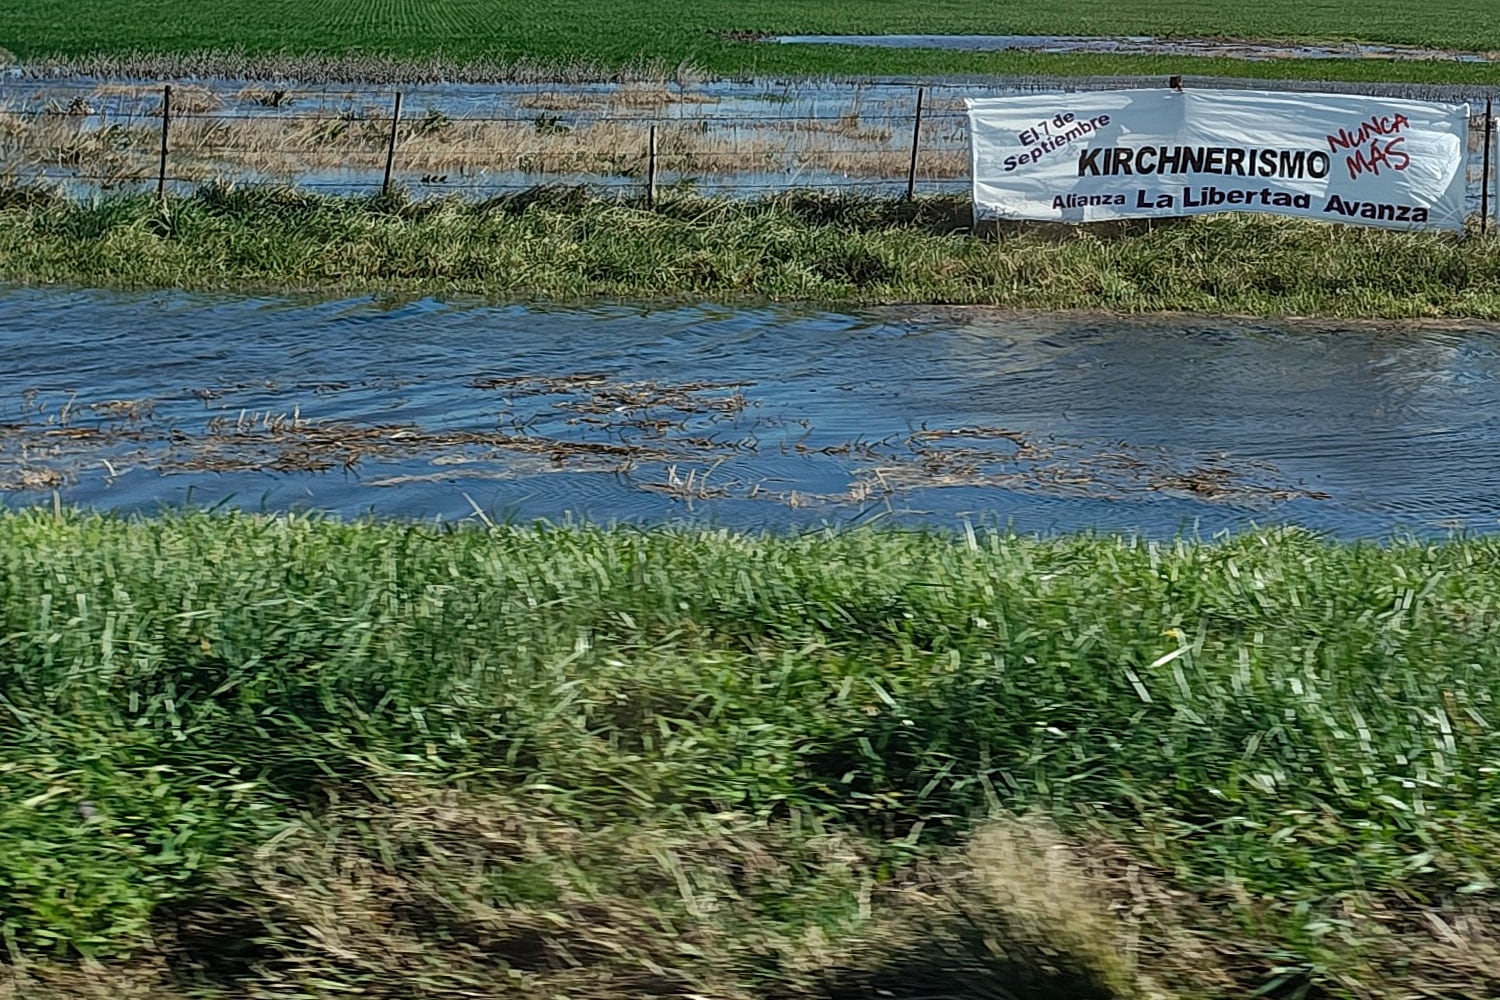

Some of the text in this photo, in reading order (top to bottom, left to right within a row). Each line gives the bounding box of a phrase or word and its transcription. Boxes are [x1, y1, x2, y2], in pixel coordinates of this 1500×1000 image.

[1003, 114, 1110, 171] Septiembre
[1018, 112, 1075, 147] El 7 de
[1326, 113, 1410, 153] NUNCA
[1078, 146, 1330, 178] KIRCHNERISMO
[1346, 138, 1410, 180] MÁS
[1052, 186, 1429, 223] Alianza La Libertad Avanza
